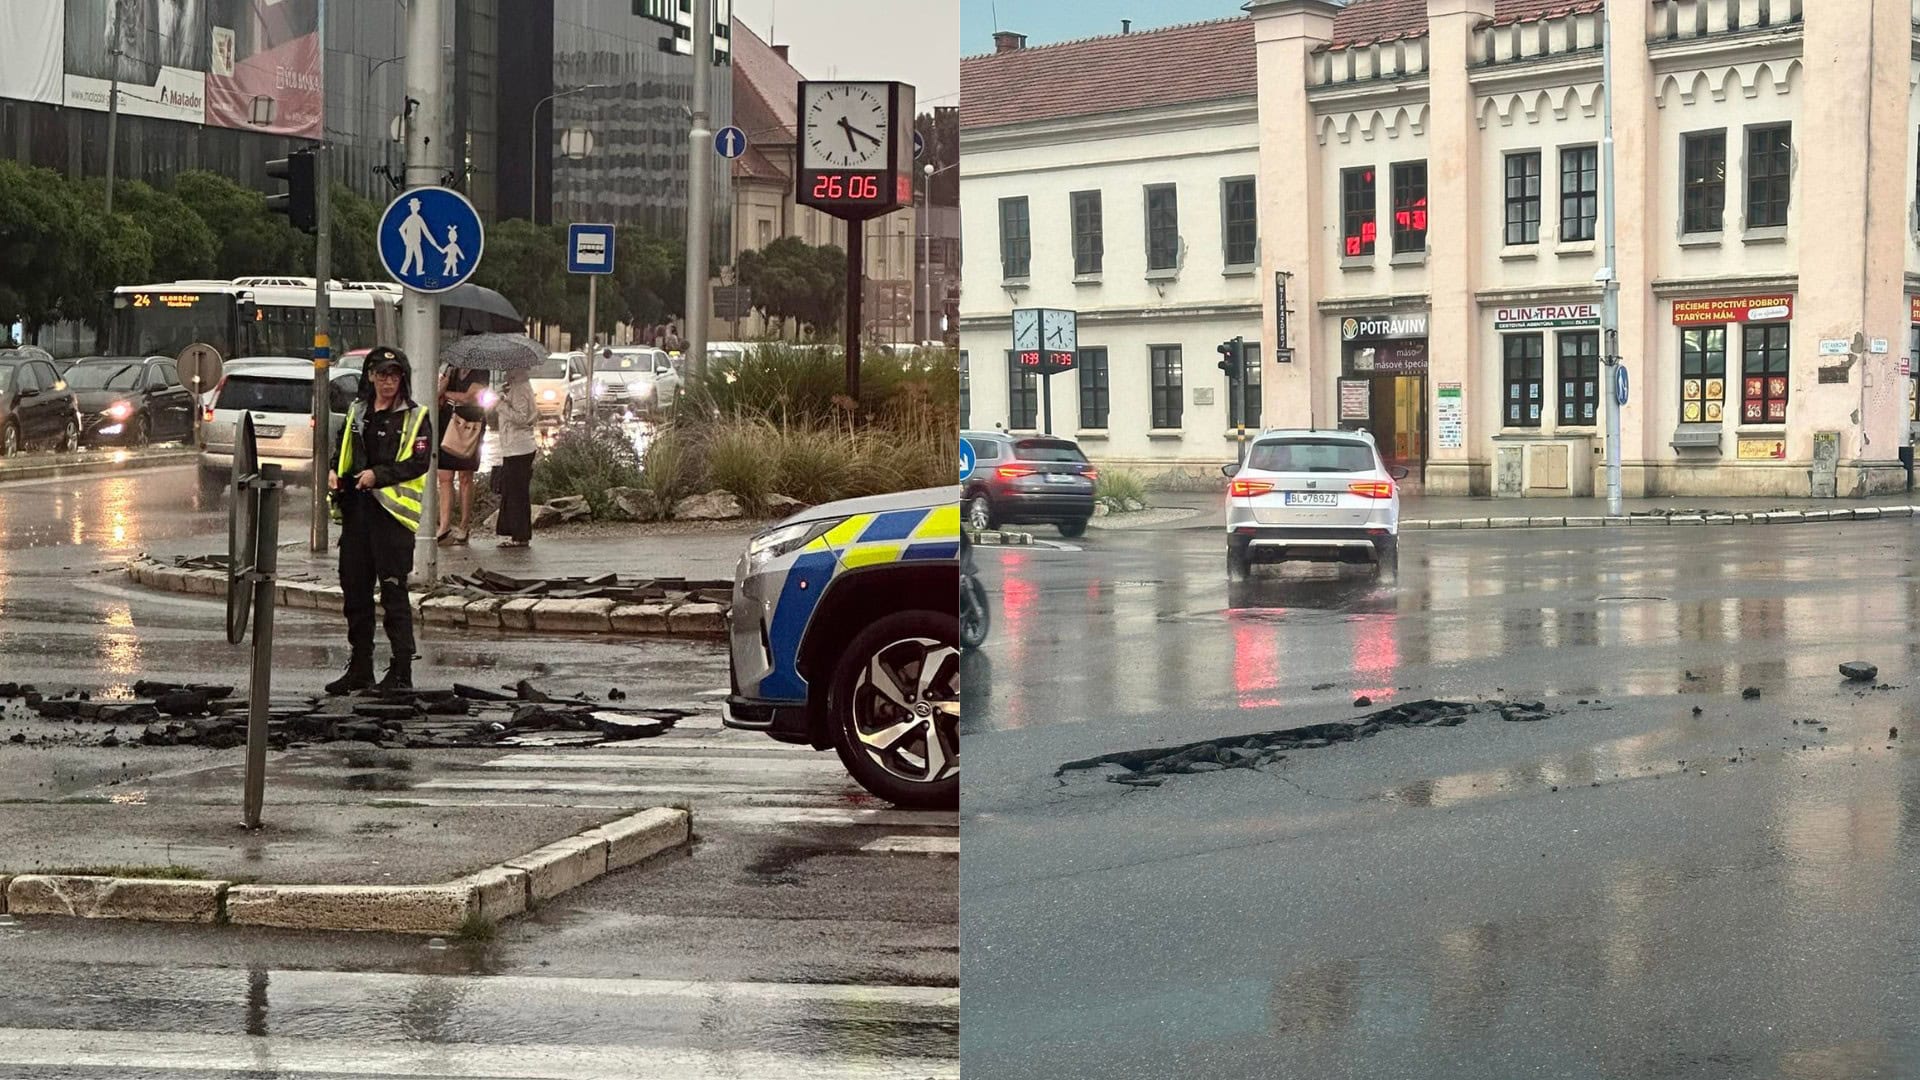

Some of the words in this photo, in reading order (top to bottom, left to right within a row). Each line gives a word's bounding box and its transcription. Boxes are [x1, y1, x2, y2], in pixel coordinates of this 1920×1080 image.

[169, 89, 202, 108] Matador
[813, 176, 842, 198] 26
[848, 176, 877, 198] 06
[134, 294, 151, 306] 24
[1675, 302, 1710, 310] PEČIEME
[1711, 299, 1748, 309] POCTIVÉ
[1748, 298, 1790, 307] DOBROTY
[1498, 308, 1532, 321] OLIN
[1537, 305, 1597, 319] TRAVEL
[1675, 311, 1711, 321] STARÝCH
[1713, 310, 1736, 320] MÁM.
[1360, 319, 1426, 335] POTRAVINY
